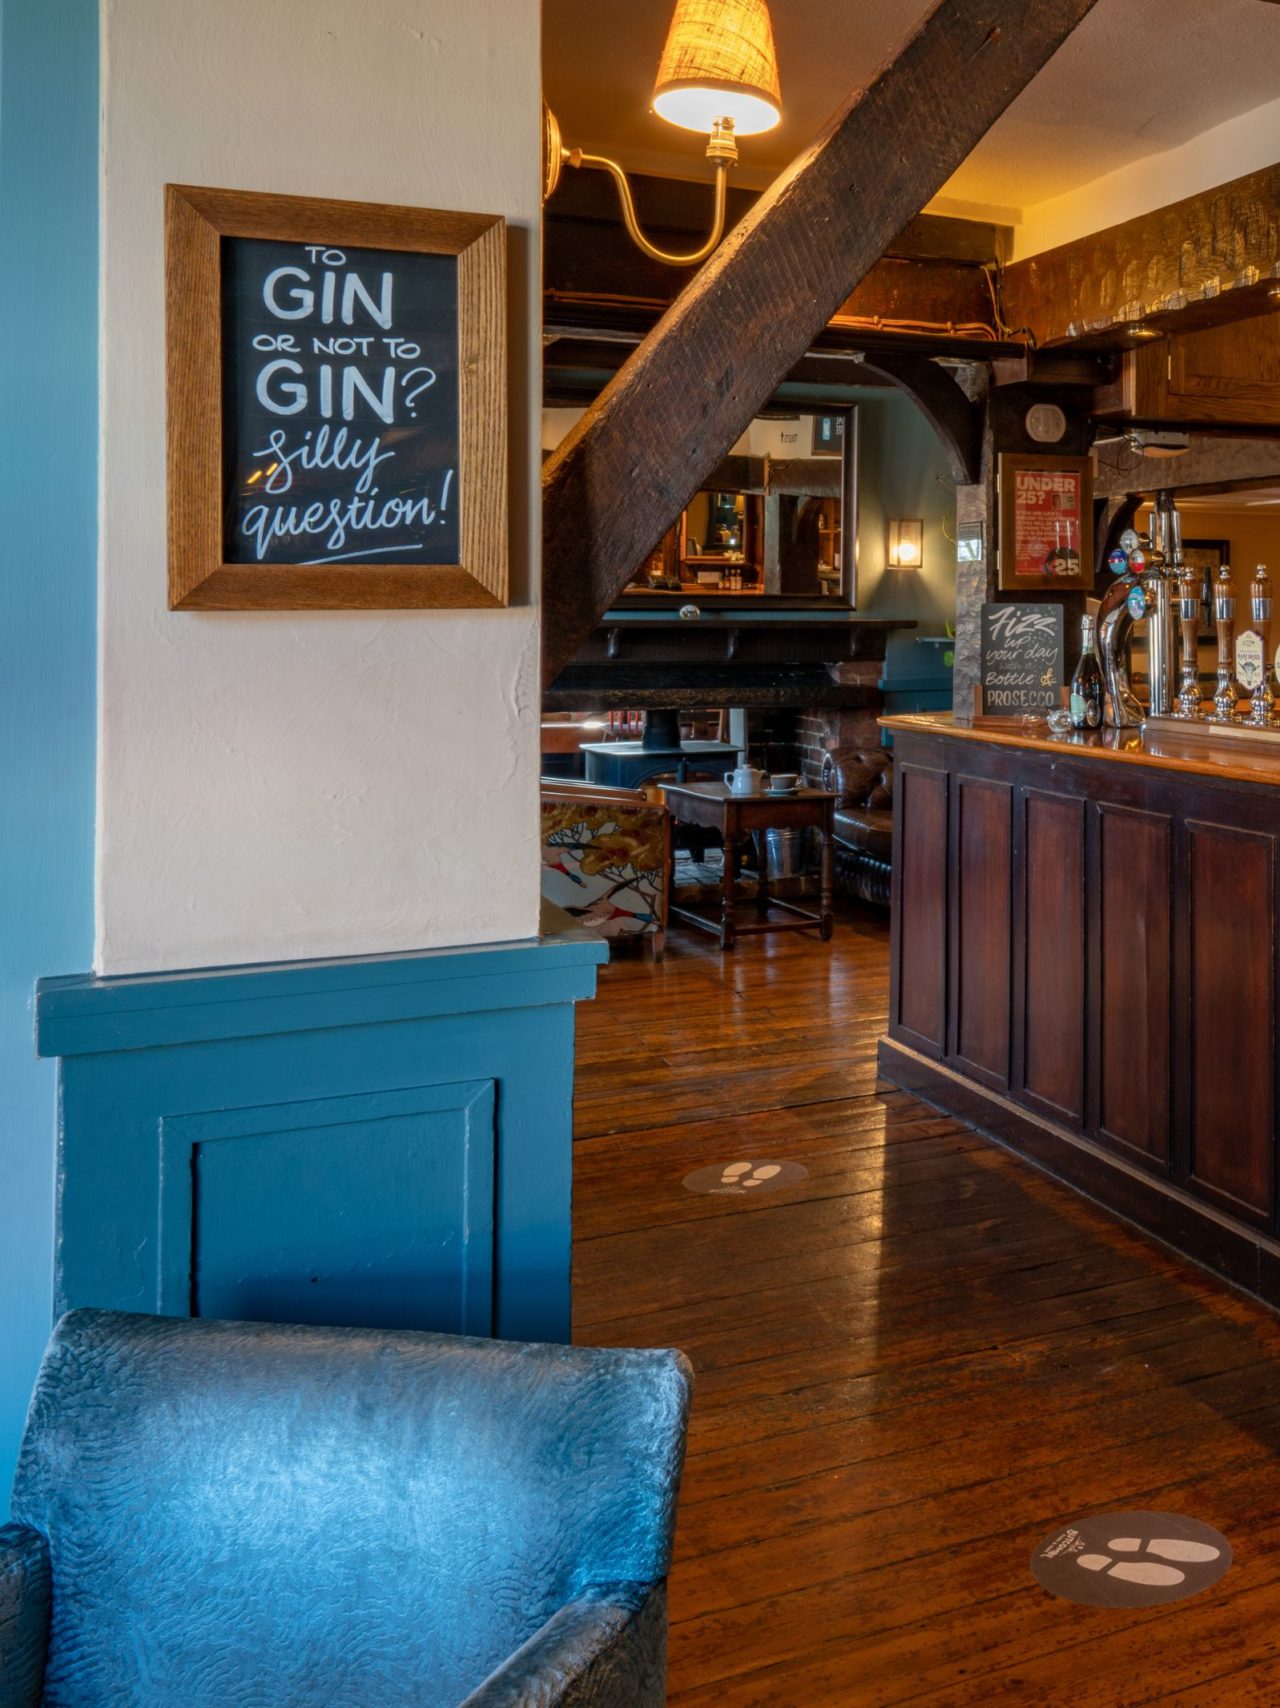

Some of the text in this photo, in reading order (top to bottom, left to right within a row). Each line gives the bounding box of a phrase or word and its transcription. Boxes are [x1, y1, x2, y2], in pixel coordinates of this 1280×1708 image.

[304, 245, 347, 266] TO
[263, 267, 393, 329] GIN
[252, 334, 421, 359] OR NOT TO
[256, 358, 437, 424] GIN?
[1016, 476, 1075, 492] UNDER
[1016, 490, 1046, 504] 25?
[241, 469, 454, 560] question!
[1055, 559, 1079, 576] 25
[986, 642, 1058, 665] your day
[985, 672, 1034, 685] Bottle
[987, 690, 1054, 707] PROSECCO
